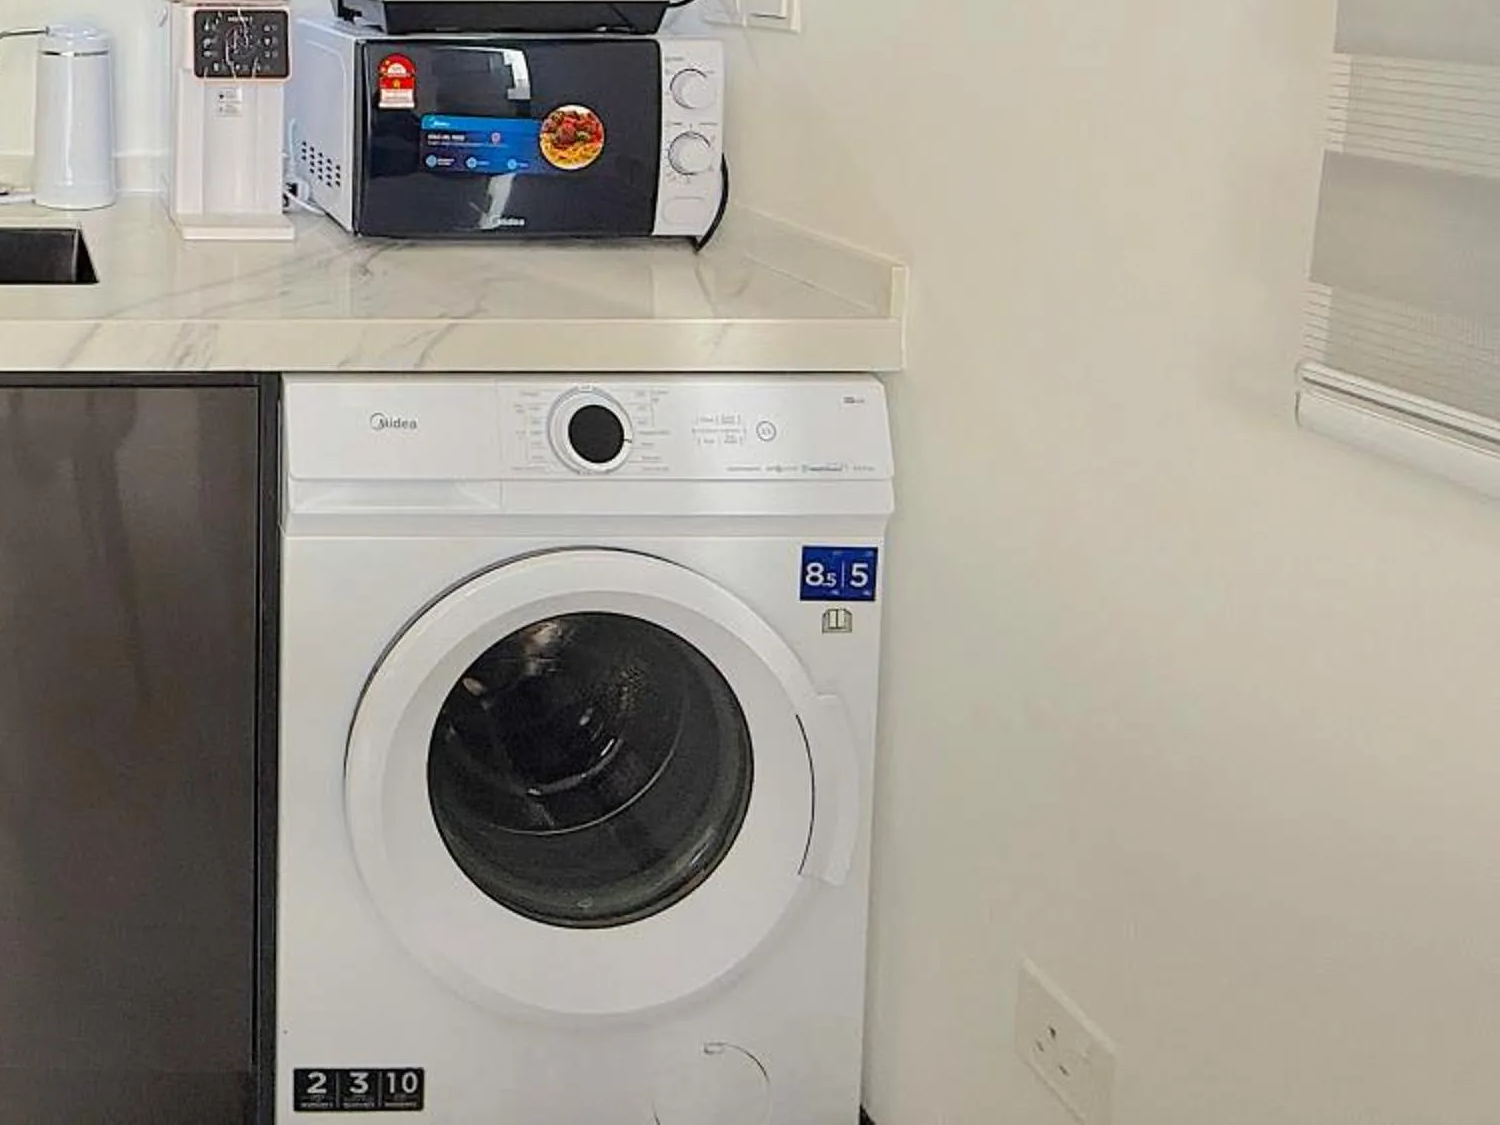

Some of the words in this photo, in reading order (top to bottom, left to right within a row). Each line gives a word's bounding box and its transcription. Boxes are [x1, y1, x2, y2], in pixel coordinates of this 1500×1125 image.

[370, 412, 417, 430] Midea
[850, 562, 869, 588] 5
[306, 1071, 327, 1094] 2
[349, 1071, 369, 1094] 3
[387, 1071, 418, 1094] 10
